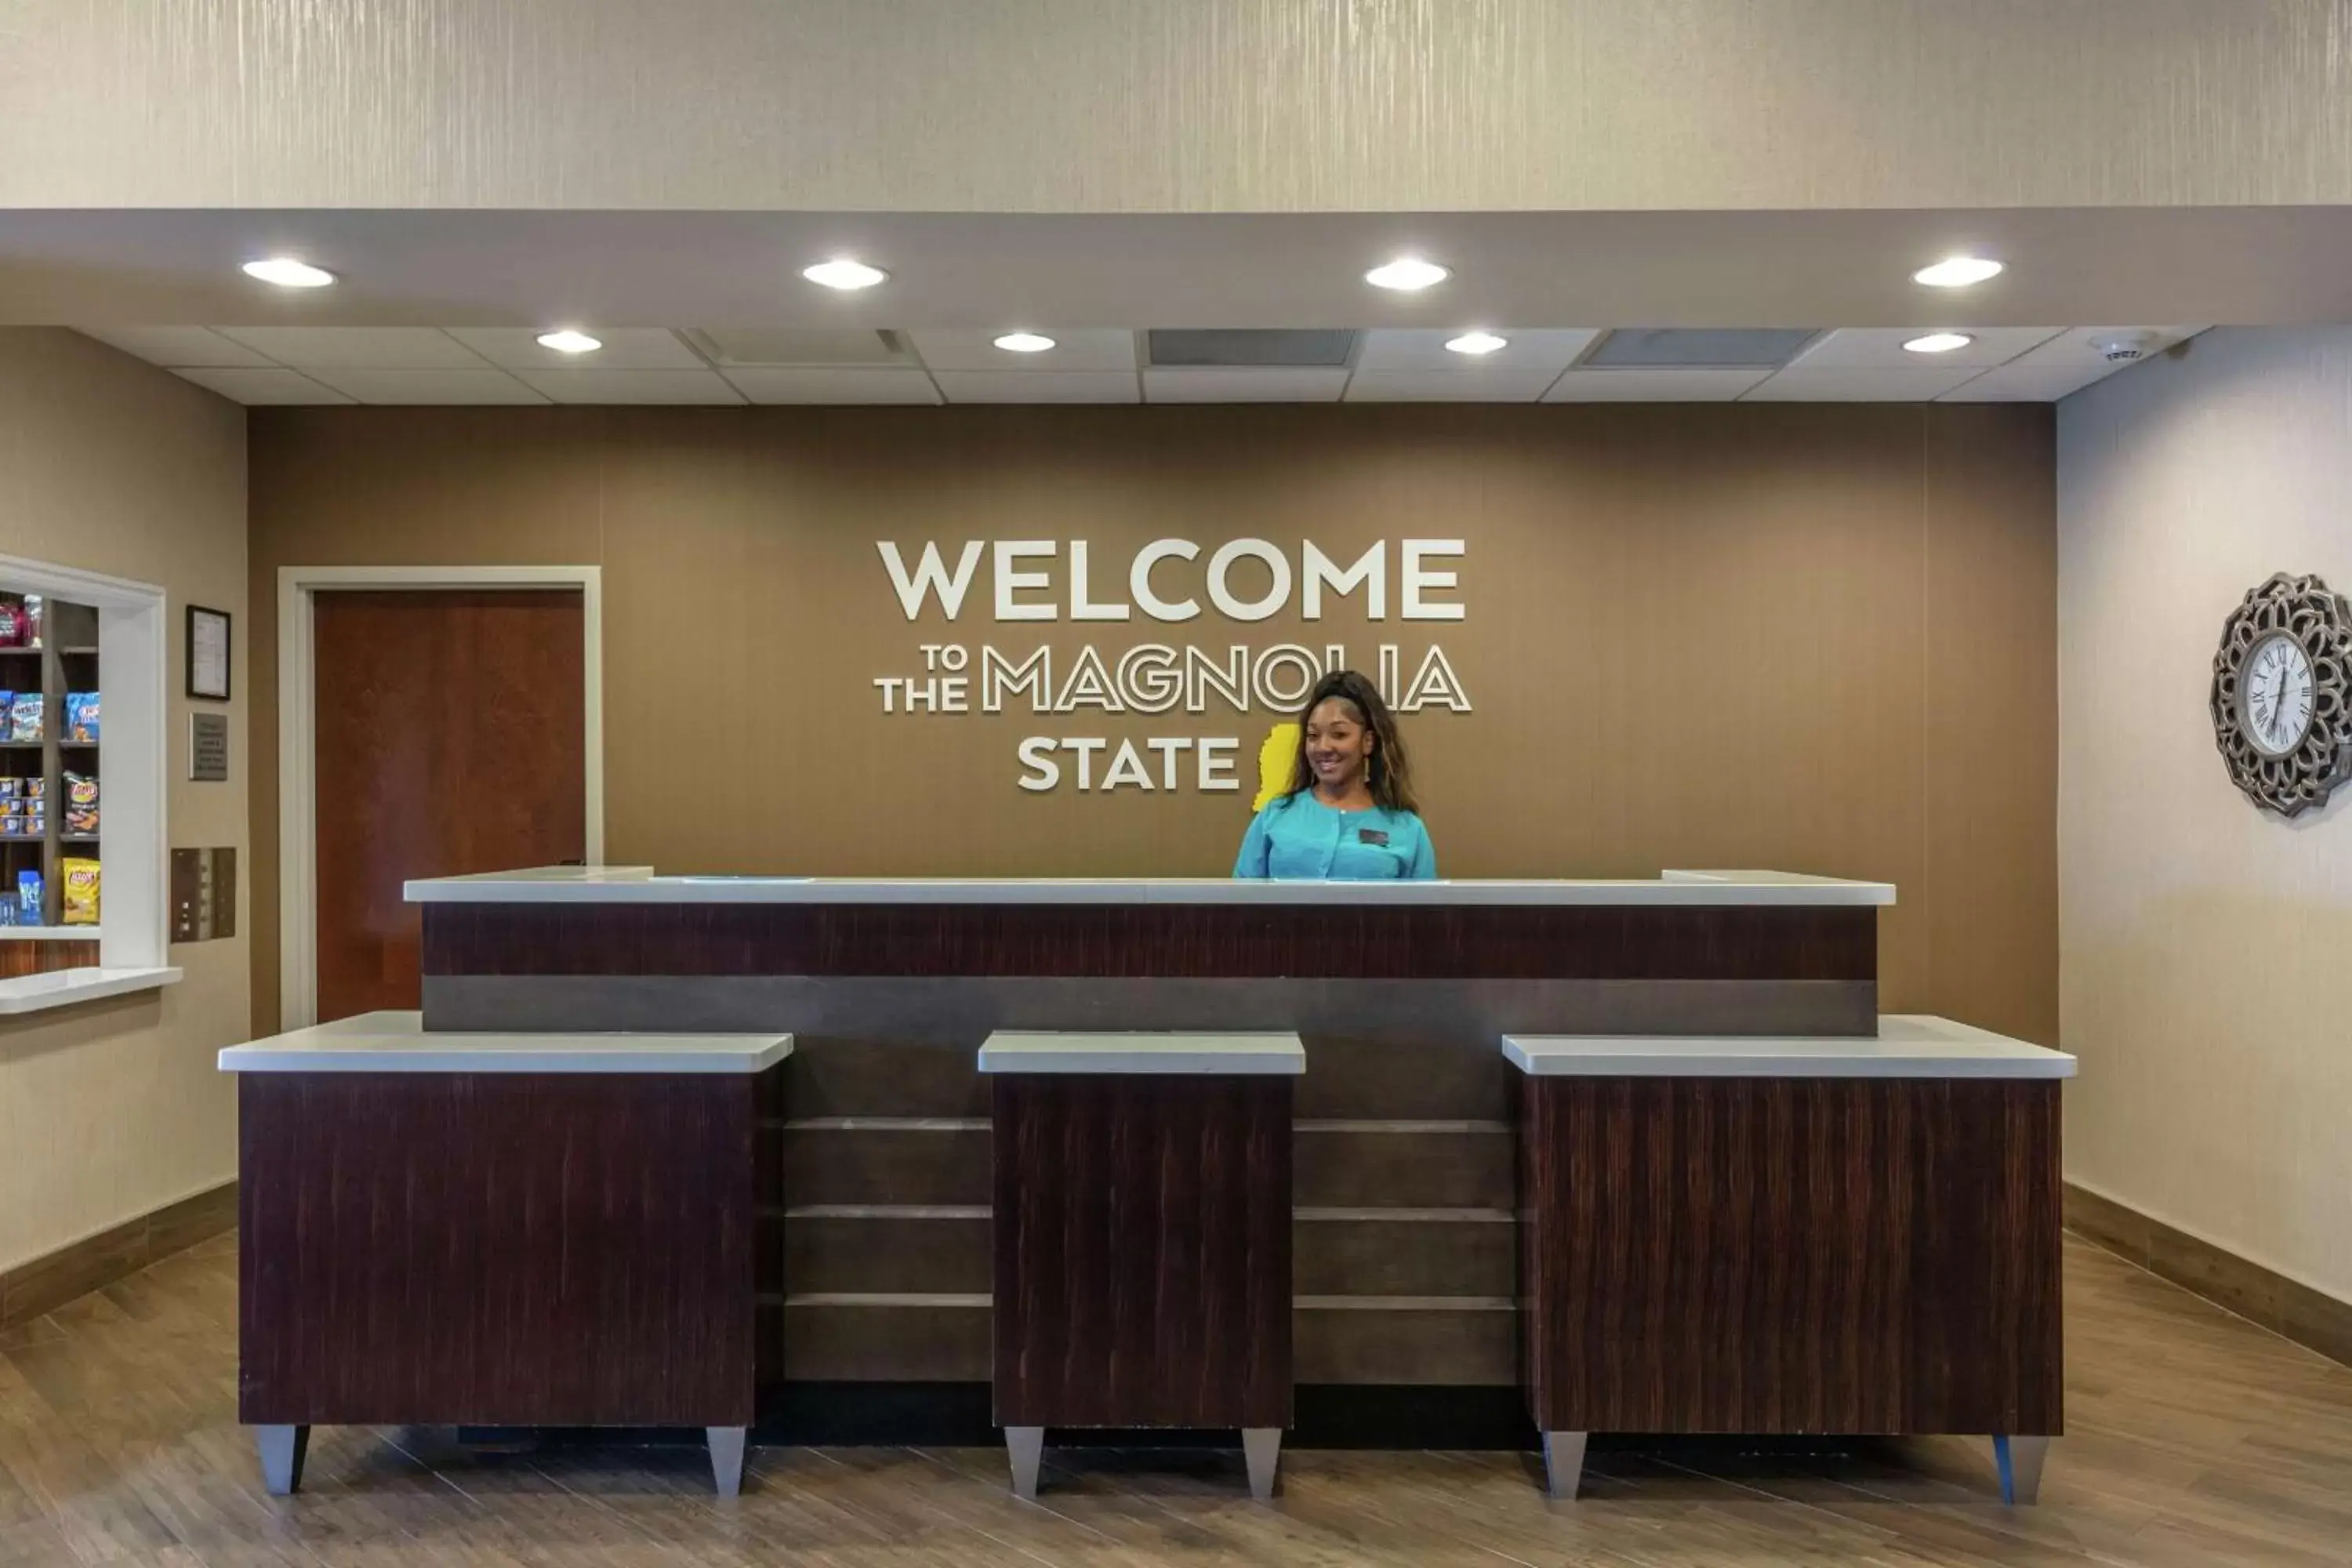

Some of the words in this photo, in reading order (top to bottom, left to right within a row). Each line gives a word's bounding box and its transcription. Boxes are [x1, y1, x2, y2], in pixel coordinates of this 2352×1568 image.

[877, 538, 1465, 621] WELCOME
[920, 644, 968, 671] TO
[873, 677, 968, 711] THE
[1018, 737, 1240, 790] STATE
